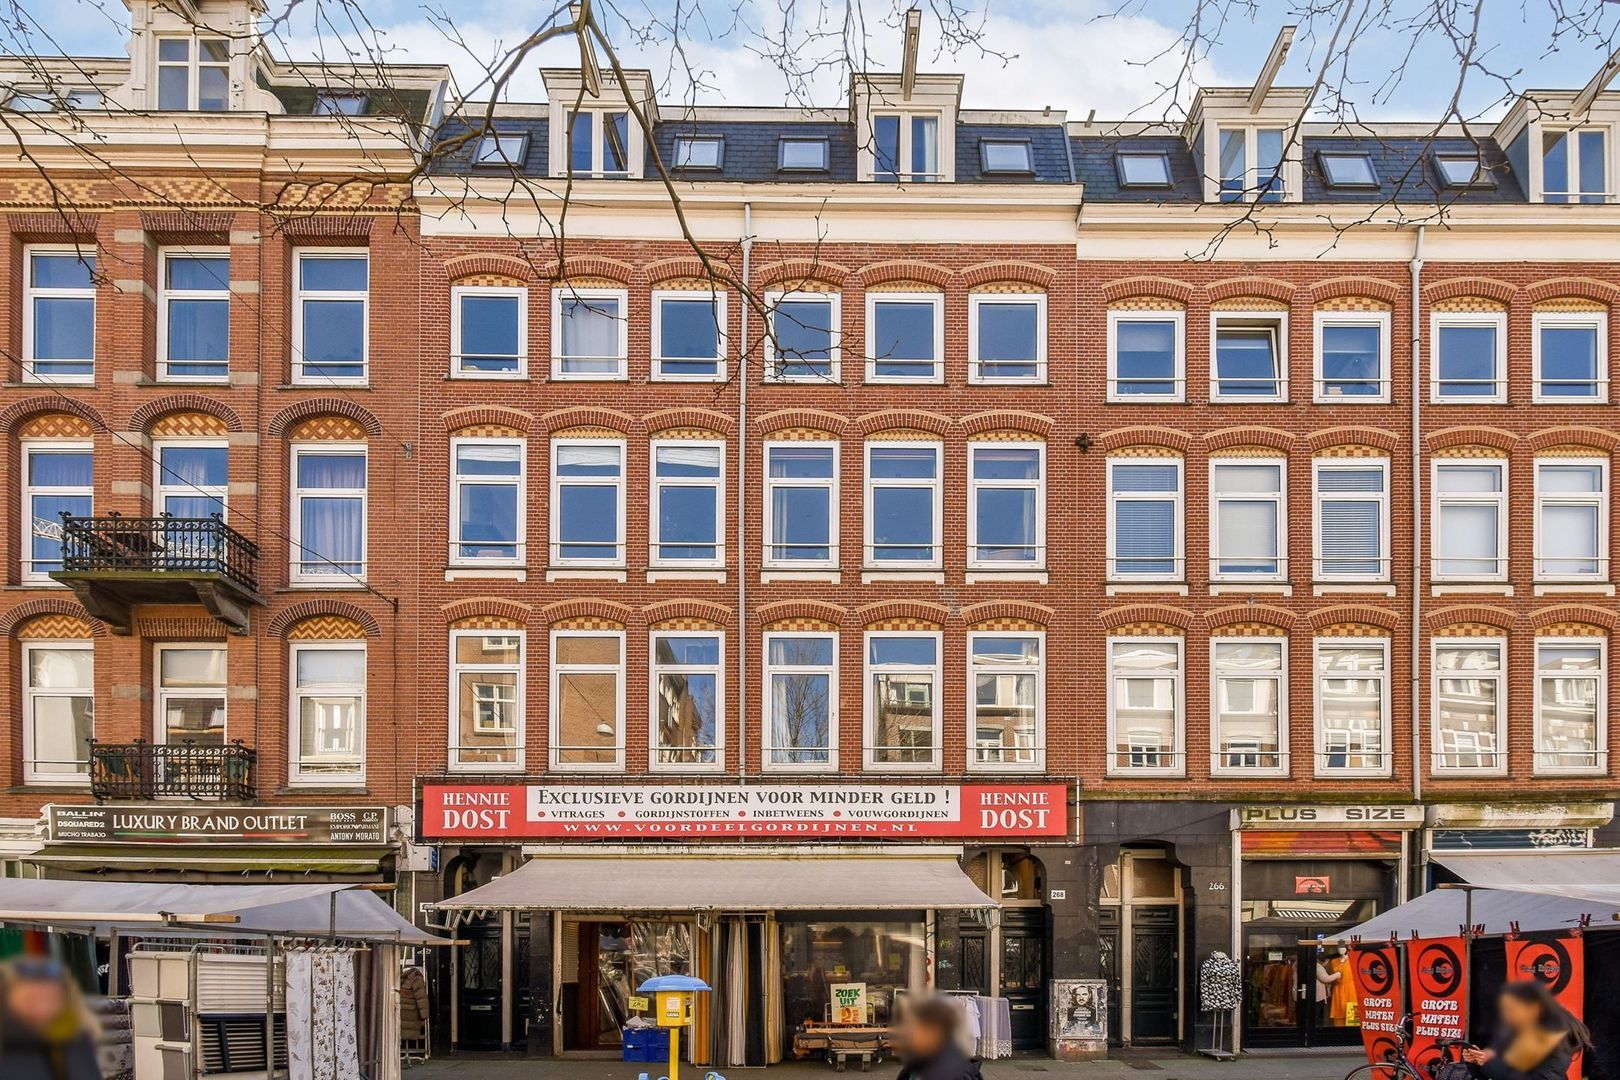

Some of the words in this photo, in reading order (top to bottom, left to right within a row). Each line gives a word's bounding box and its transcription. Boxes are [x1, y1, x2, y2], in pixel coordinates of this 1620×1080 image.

[442, 792, 510, 806] HENNIE
[538, 789, 644, 805] EXCLUSIEVE
[650, 791, 749, 806] GORDIJNEN
[756, 791, 803, 804] VOOR
[809, 791, 884, 804] MINDER
[891, 791, 936, 804] GELD
[980, 792, 1049, 806] HENNIE
[330, 812, 356, 820] BOSS
[442, 809, 511, 830] DOST
[550, 810, 605, 818] VITRAGES
[635, 810, 730, 819] GORDIJNSTOFFEN
[753, 810, 824, 818] INBETWEENS
[848, 810, 949, 819] VOUWGORDIJNEN
[980, 809, 1050, 829] DOST
[1246, 808, 1317, 821] PLUS
[1345, 808, 1406, 820] SIZE
[57, 820, 105, 828] DSQUARED2
[113, 814, 177, 830] LUXURY
[181, 815, 239, 830] BRAND
[243, 815, 308, 830] OUTLET
[330, 832, 354, 841] ANTONY
[355, 832, 380, 841] MORATO
[835, 988, 861, 998] ZOEK
[839, 997, 858, 1006] UIT
[1363, 997, 1392, 1008] GROTE
[1421, 1000, 1458, 1011] GROTE
[1365, 1010, 1394, 1021] MATEN
[1420, 1014, 1459, 1026] MATEN
[1361, 1021, 1380, 1031] PLUS
[1416, 1026, 1440, 1037] PLUS
[1440, 1028, 1462, 1038] SIZE
